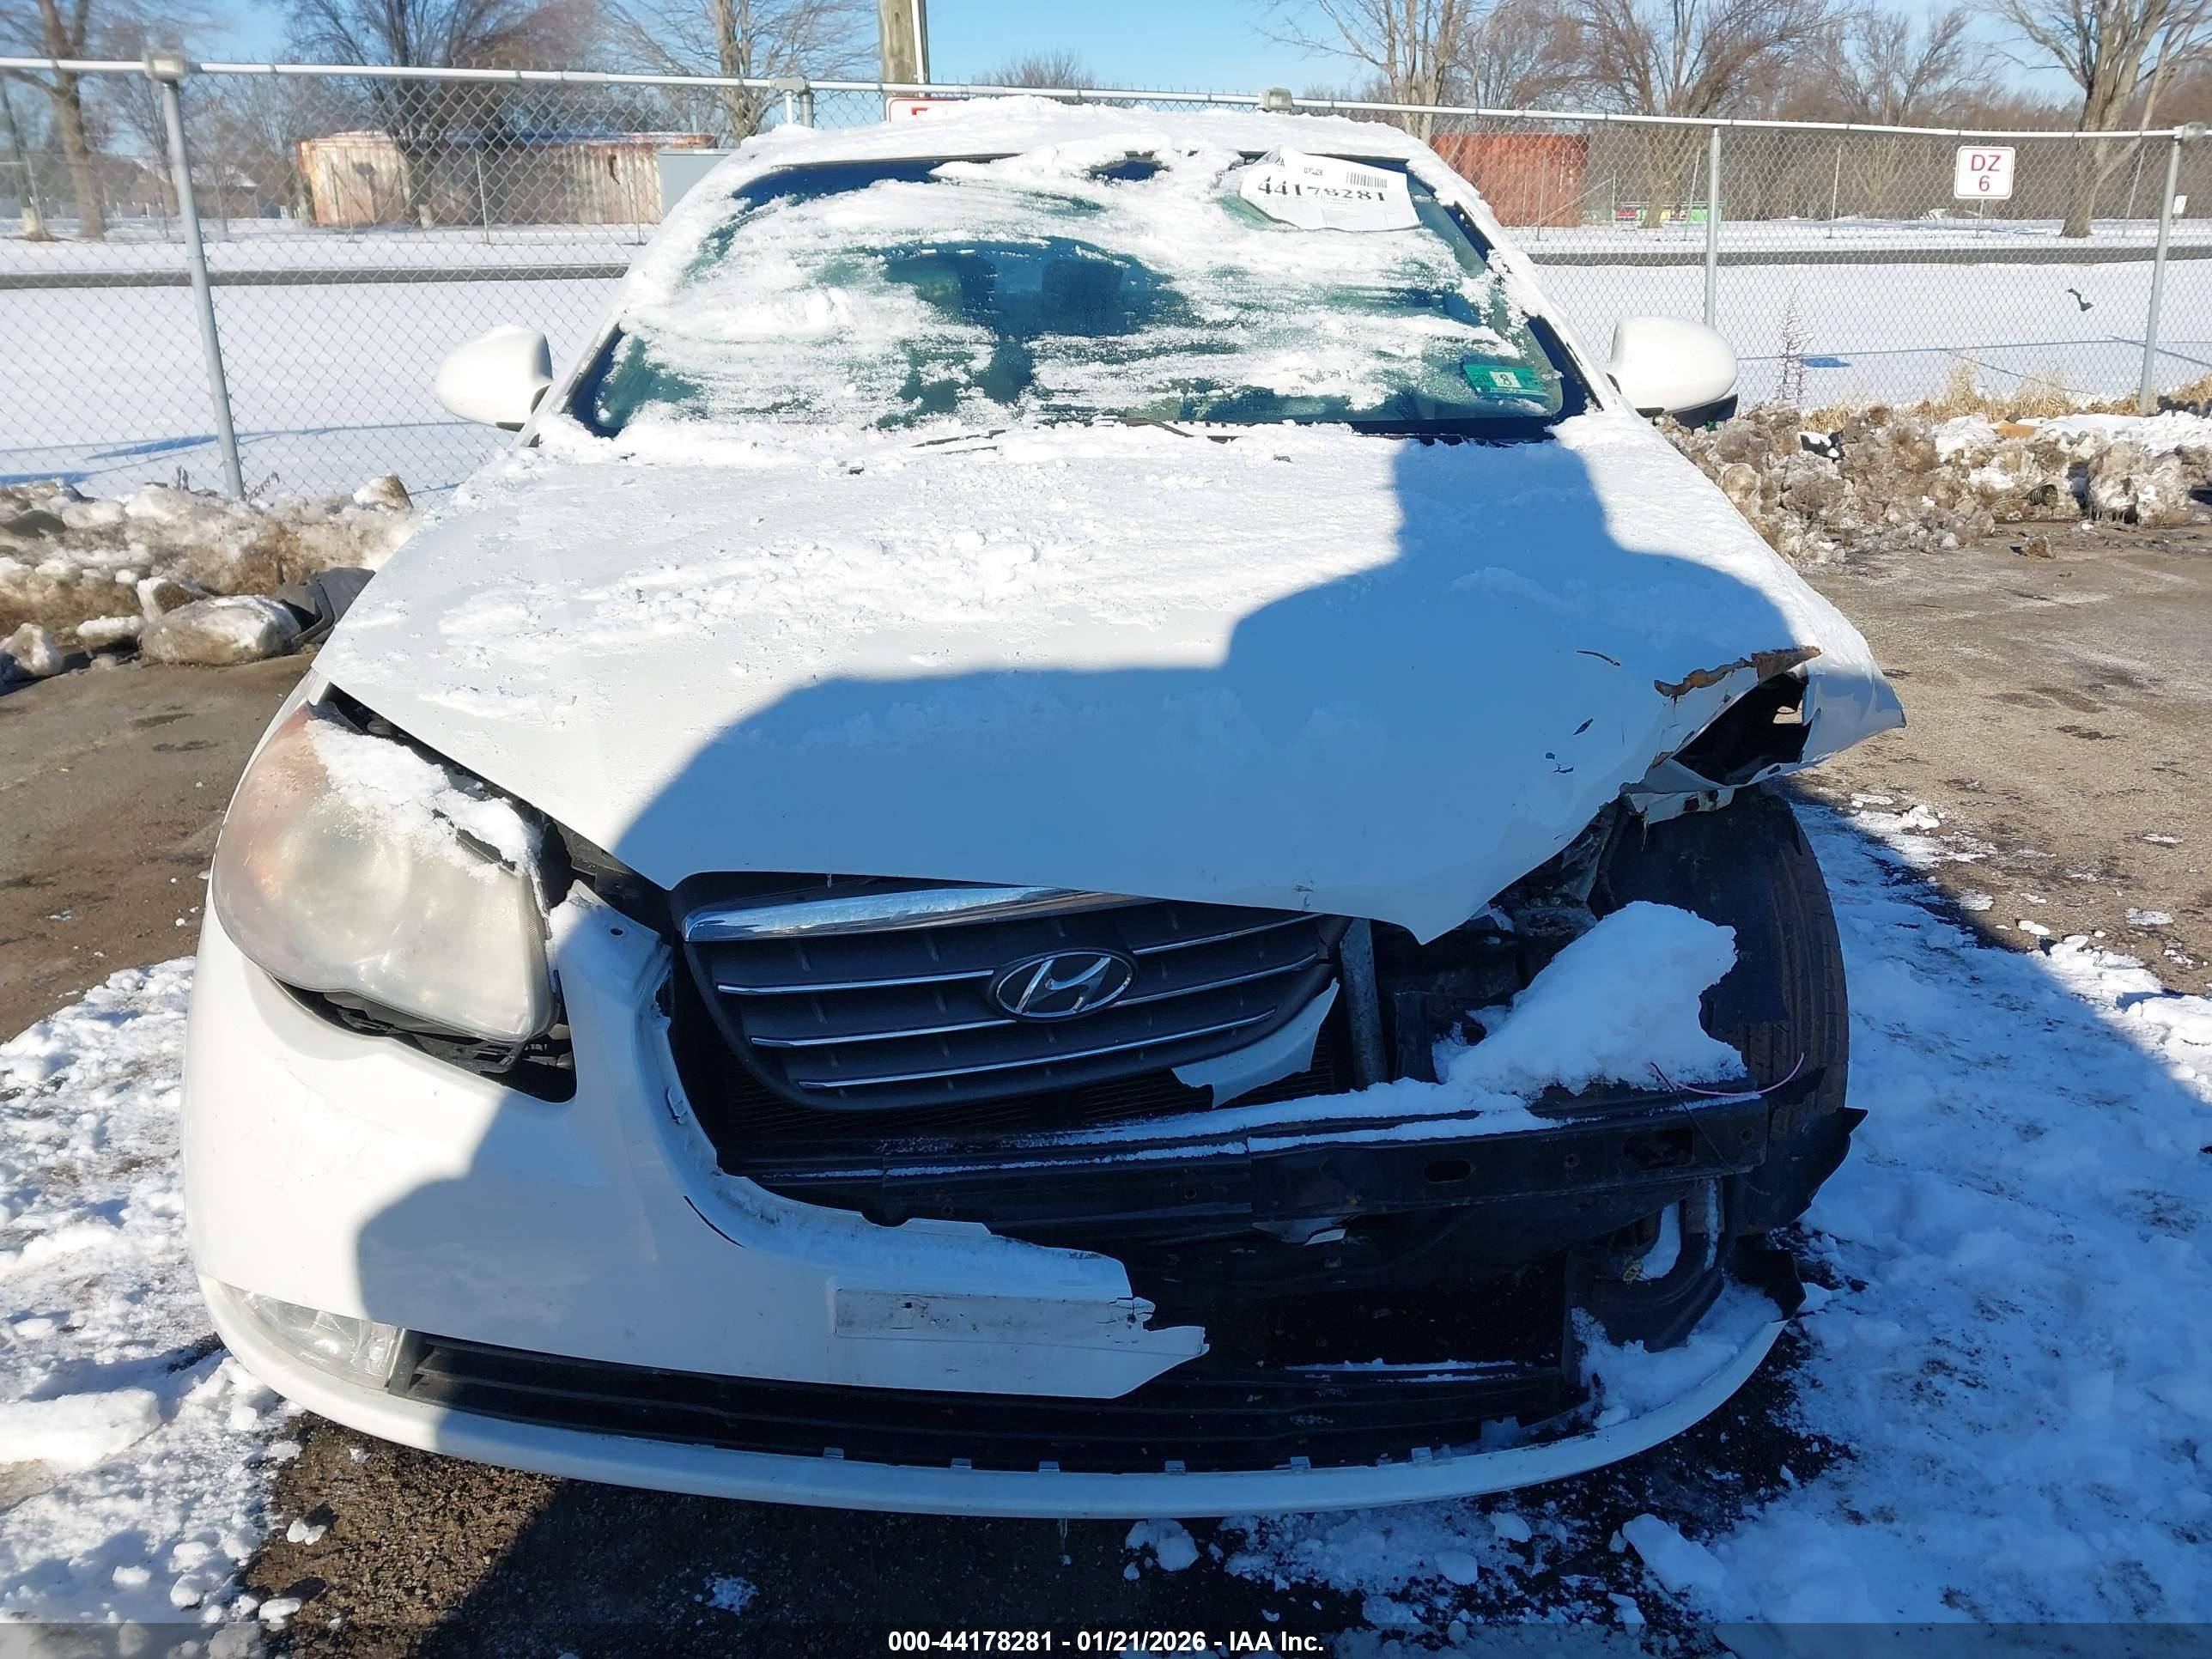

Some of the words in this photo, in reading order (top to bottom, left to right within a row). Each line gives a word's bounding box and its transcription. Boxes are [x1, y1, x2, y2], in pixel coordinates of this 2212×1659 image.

[1971, 155, 2001, 172] DZ
[1257, 175, 1385, 202] 44178281
[1978, 175, 1990, 191] 6
[1499, 374, 1513, 386] 8
